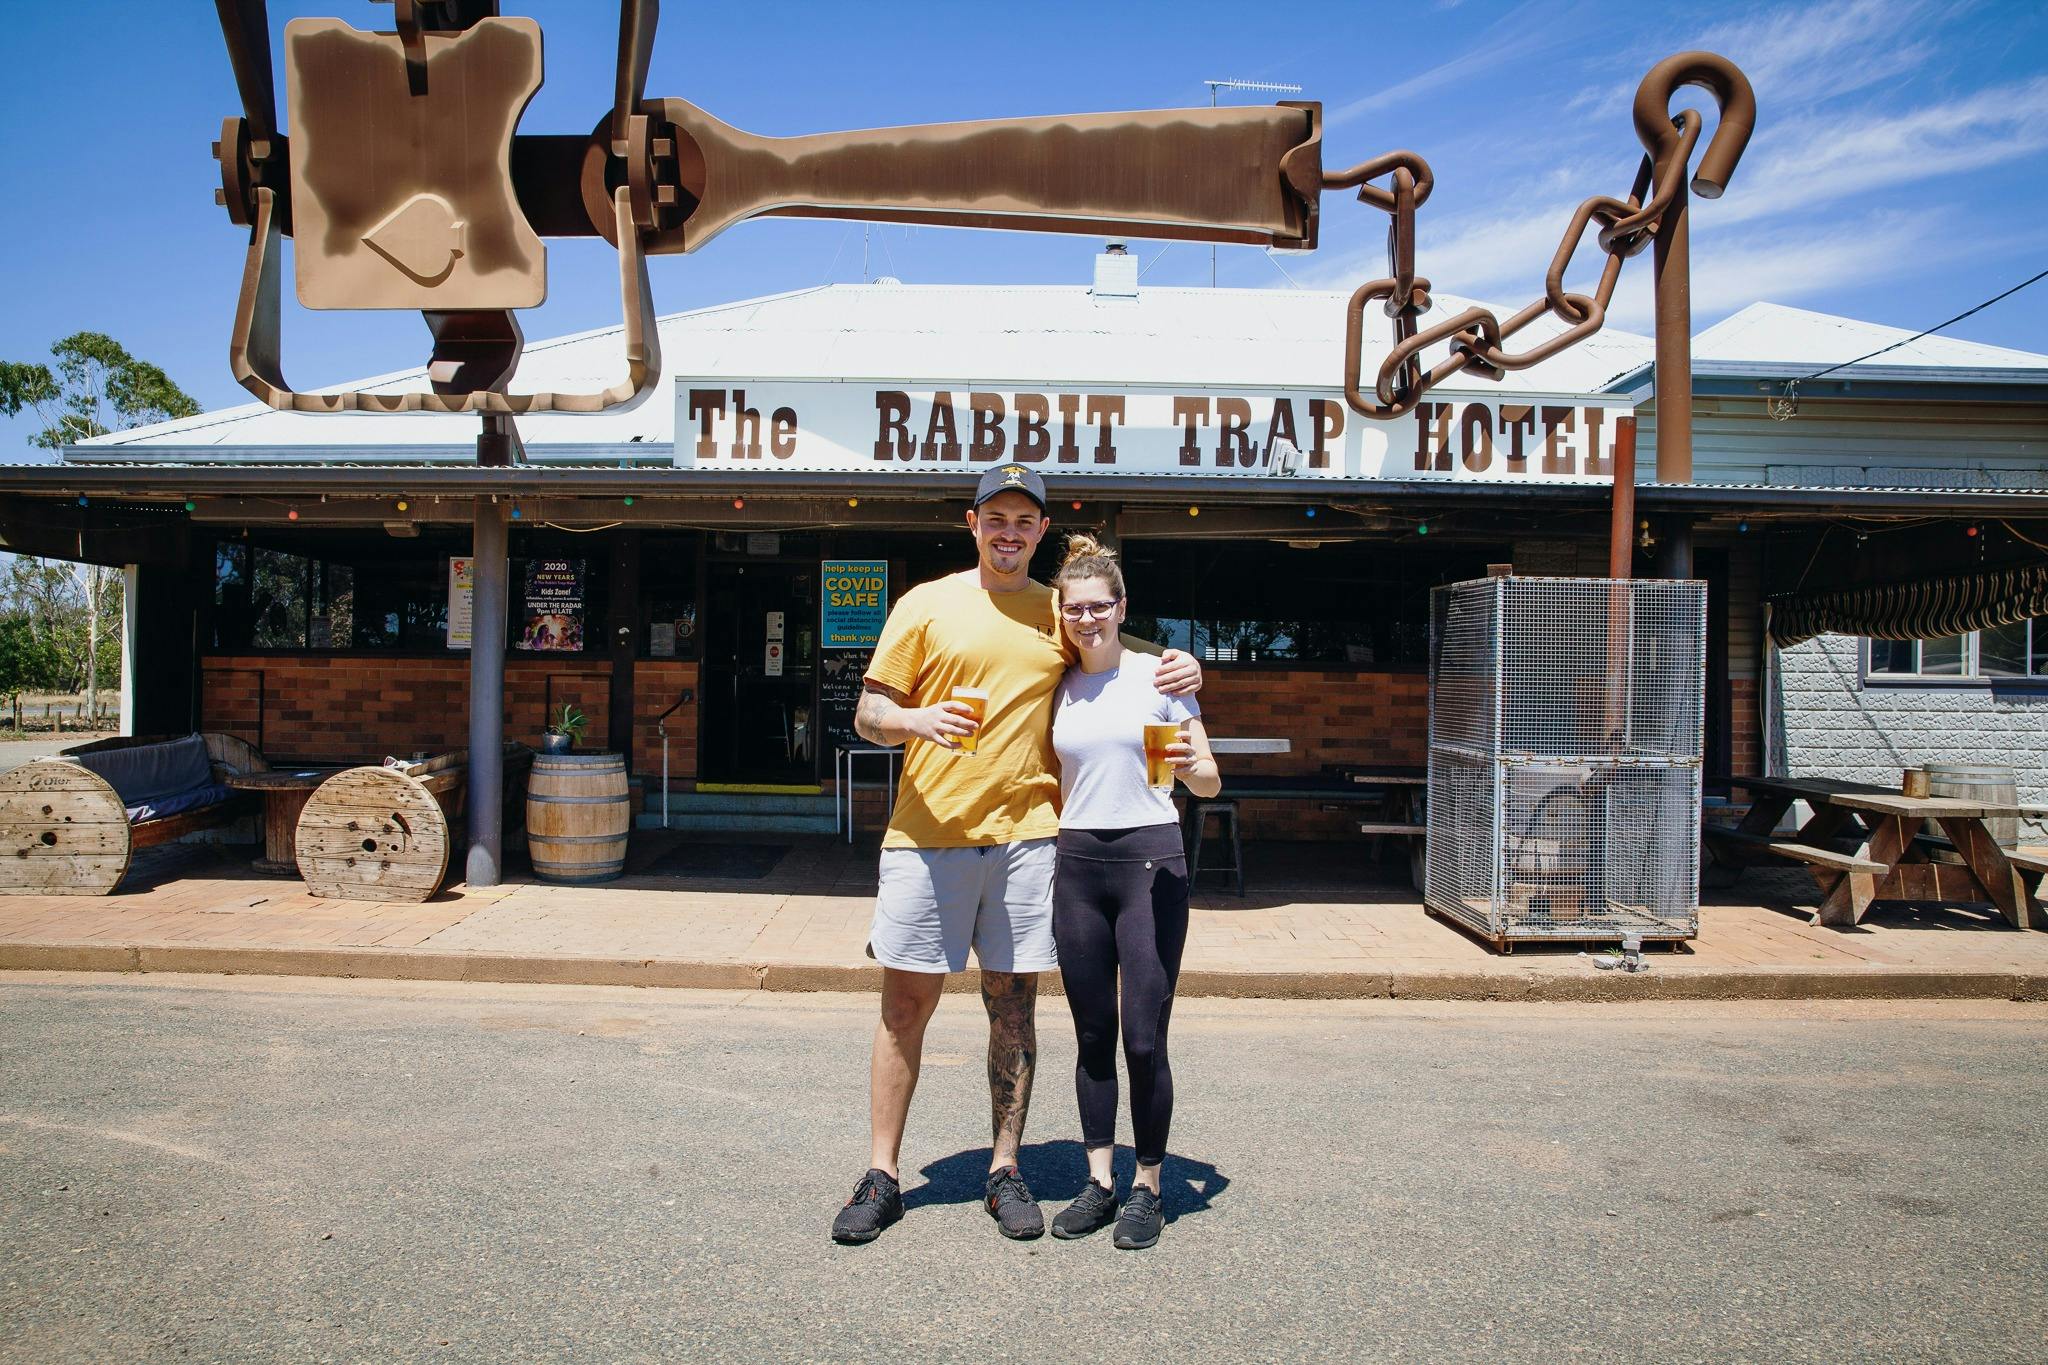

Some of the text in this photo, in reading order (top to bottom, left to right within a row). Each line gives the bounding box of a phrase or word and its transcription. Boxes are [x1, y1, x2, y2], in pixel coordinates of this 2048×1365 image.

[689, 389, 1616, 477] The RABBIT TRAP HOTEL
[544, 562, 567, 571] 2020
[825, 564, 846, 574] help
[847, 564, 871, 574] keep
[825, 577, 884, 591] COVID
[541, 588, 554, 596] Kids
[830, 592, 879, 607] SAFE
[537, 607, 550, 615] 9pm
[831, 633, 877, 643] thank you
